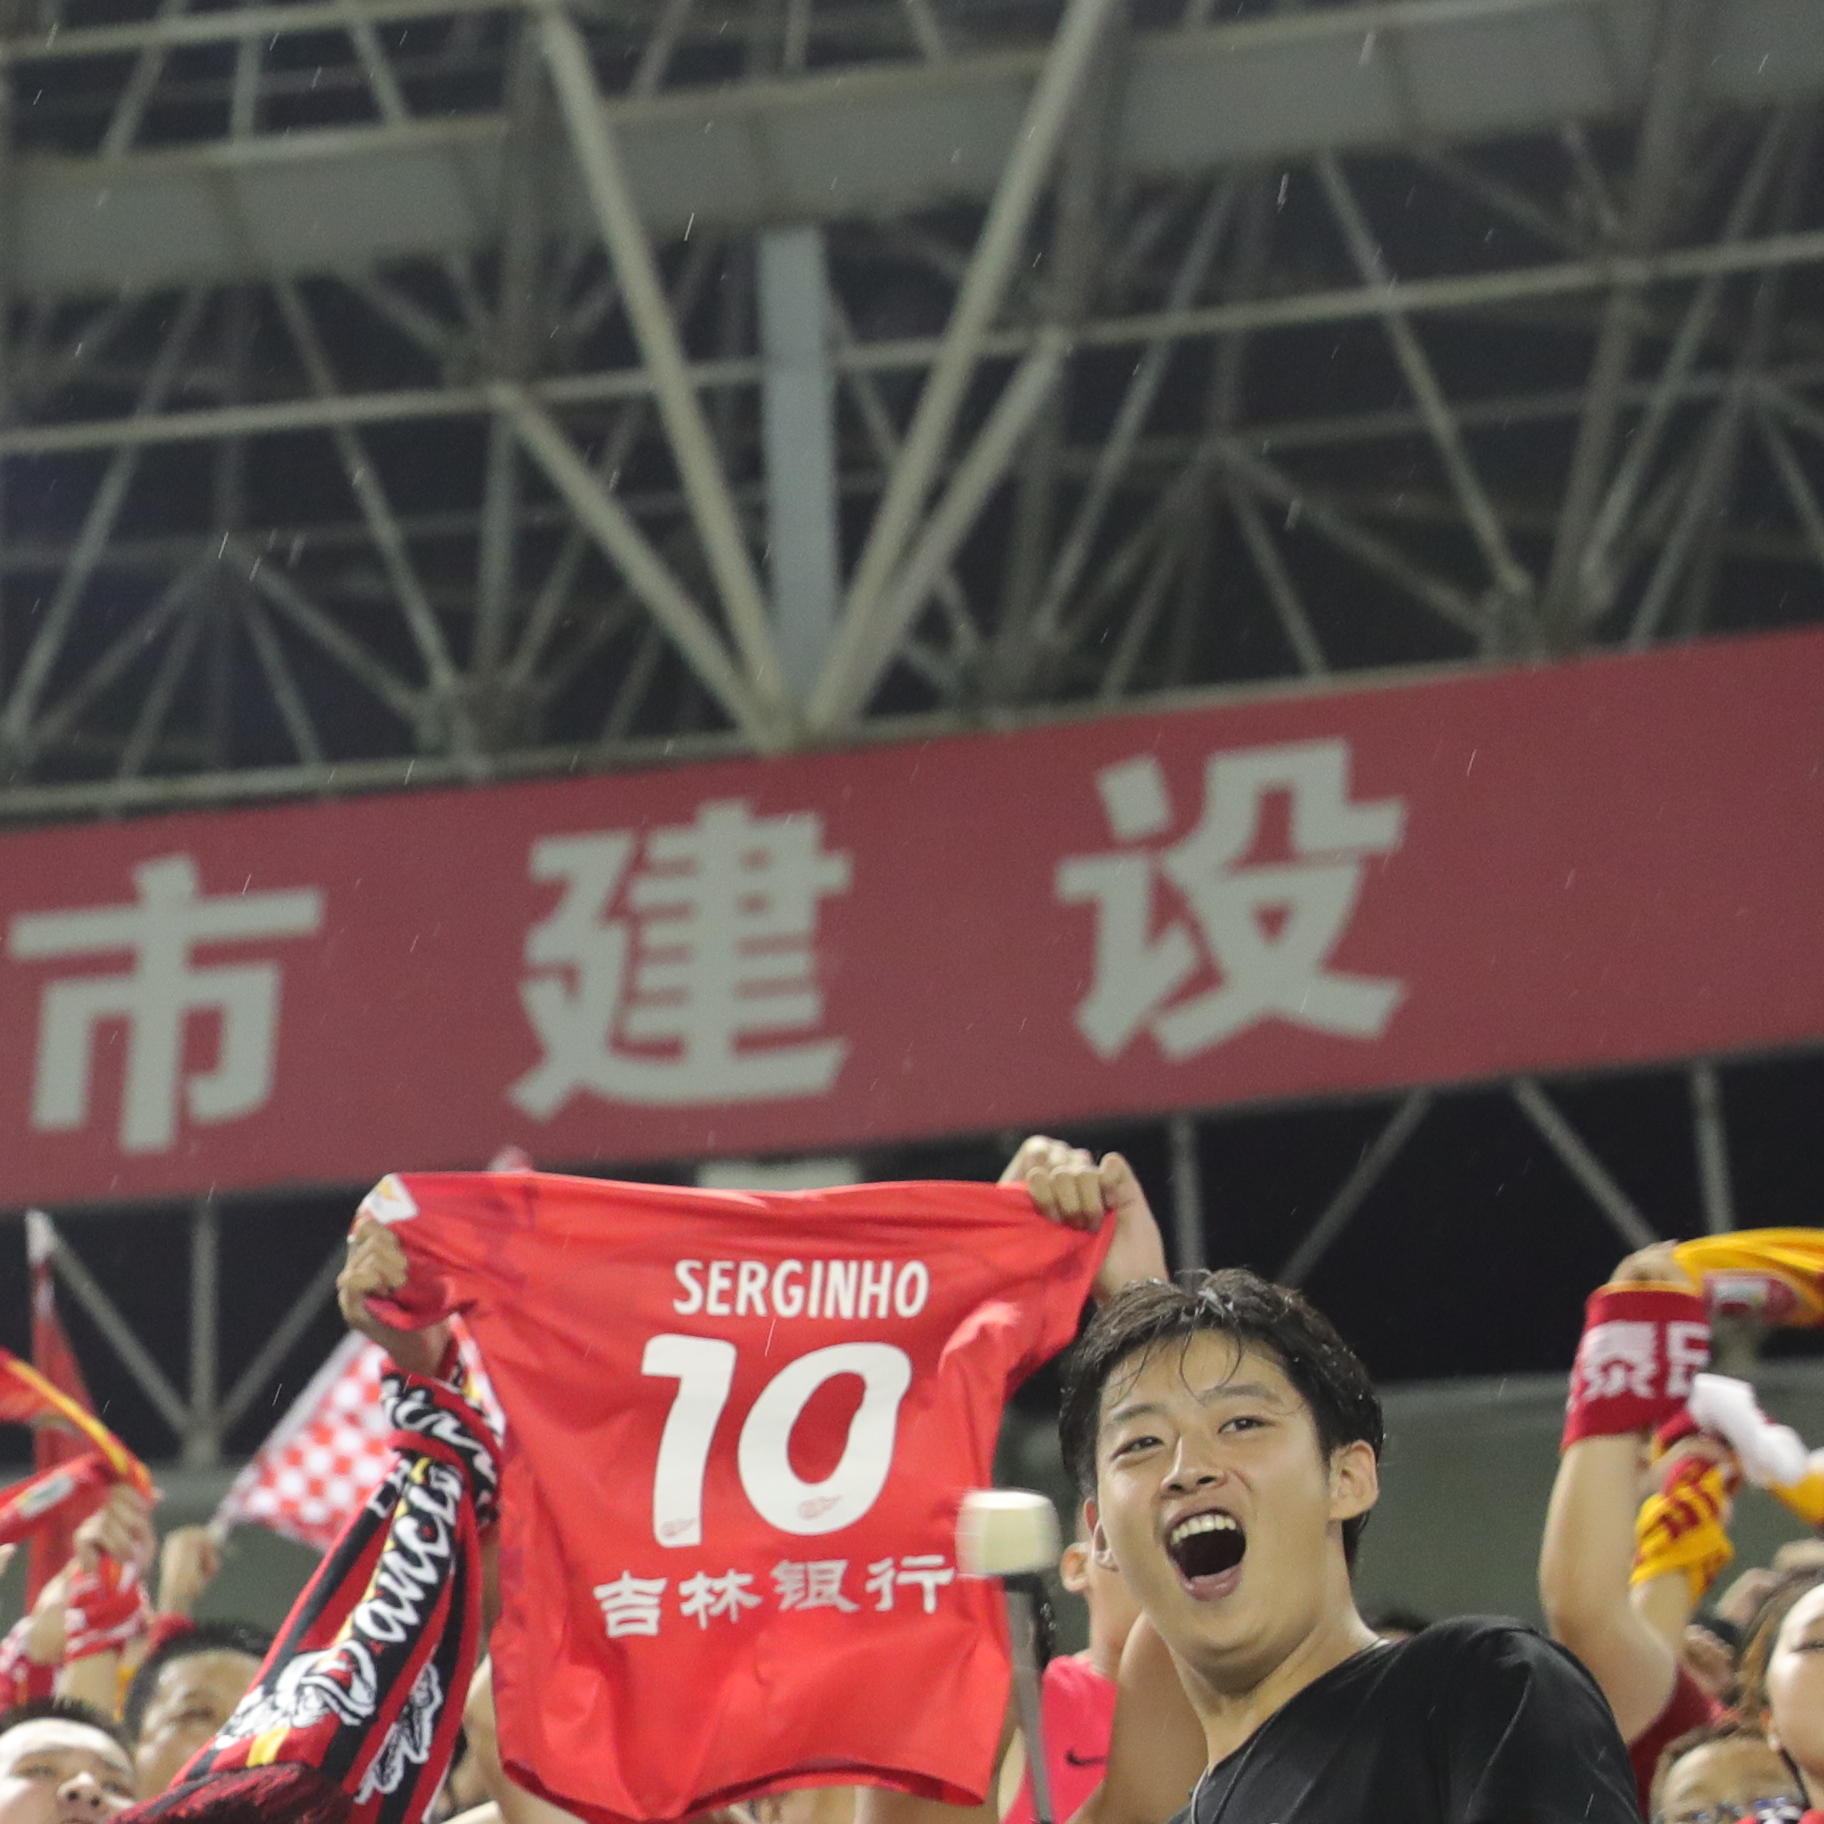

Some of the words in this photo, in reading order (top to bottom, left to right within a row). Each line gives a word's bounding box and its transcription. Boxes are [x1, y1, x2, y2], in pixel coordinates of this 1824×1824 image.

[672, 1259, 929, 1319] SERGINHO
[641, 1333, 913, 1548] 10
[592, 1554, 955, 1638] 吉林银行
